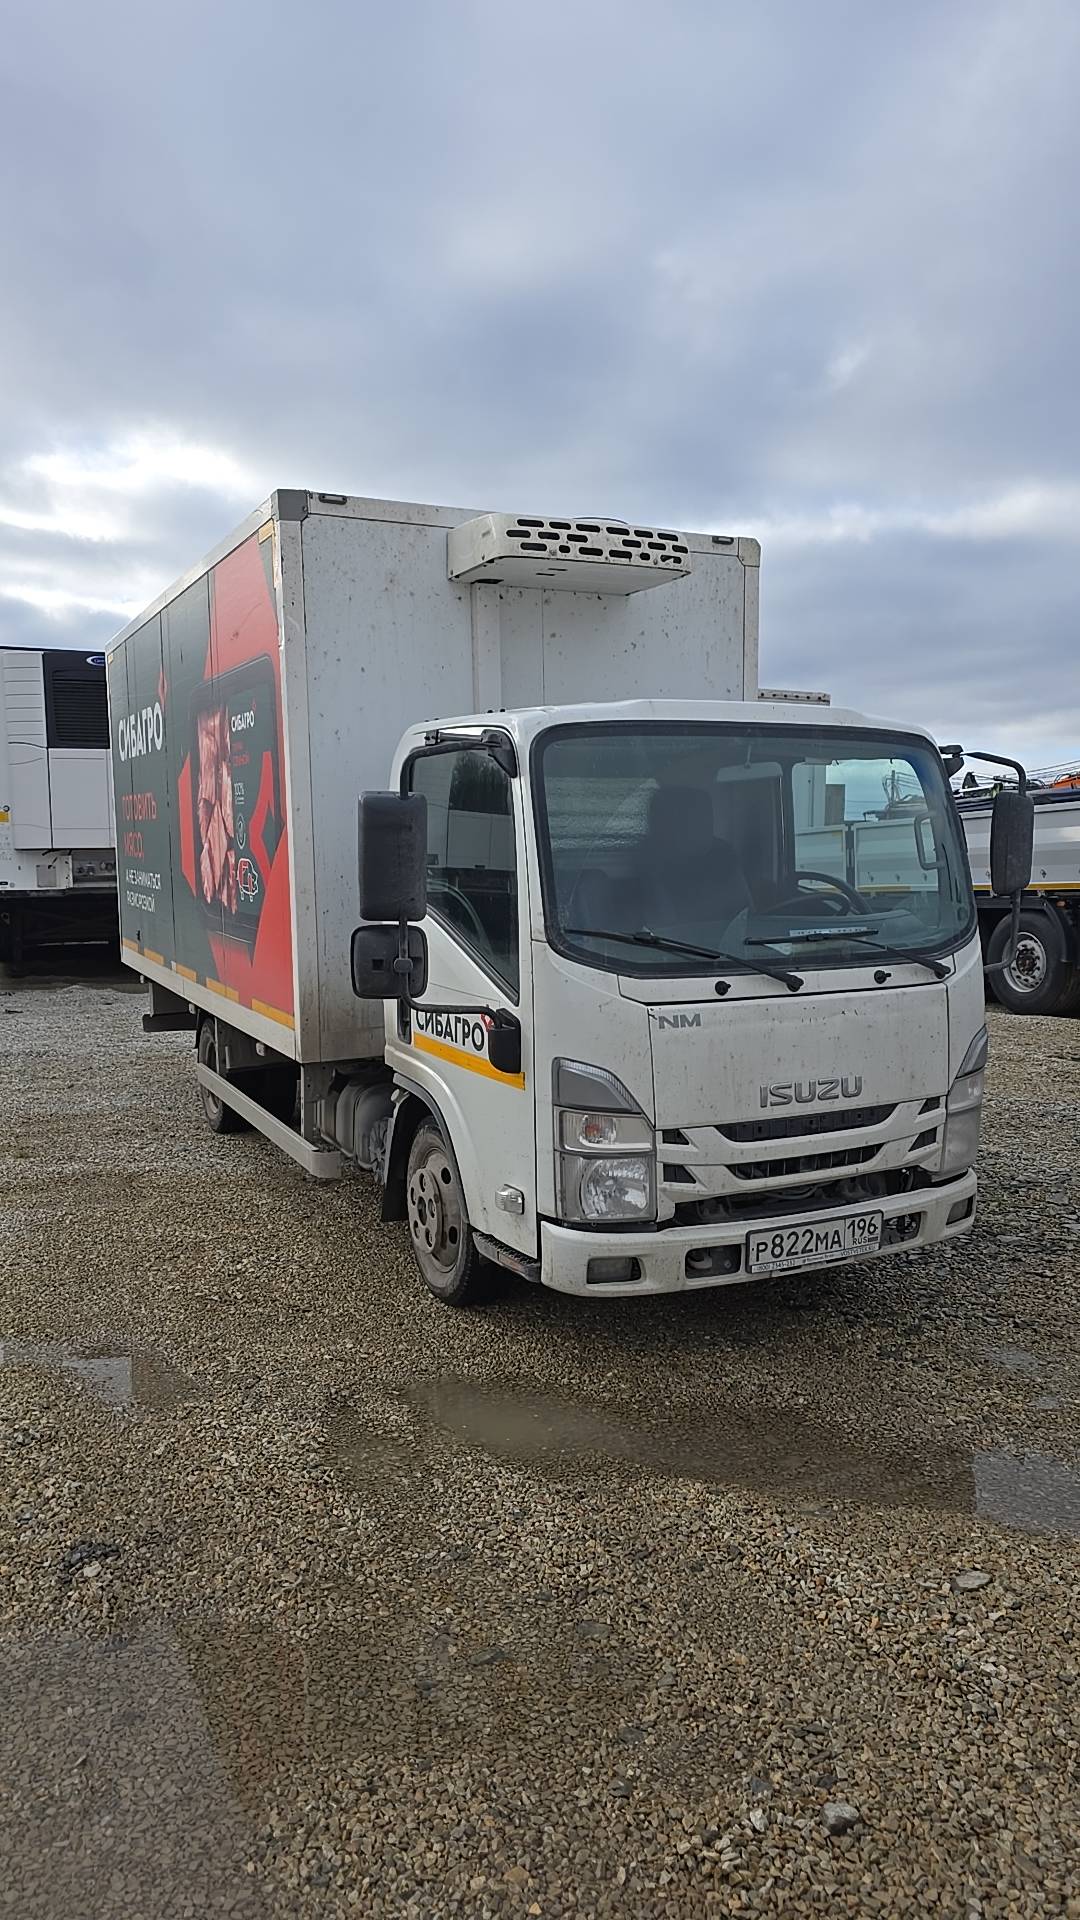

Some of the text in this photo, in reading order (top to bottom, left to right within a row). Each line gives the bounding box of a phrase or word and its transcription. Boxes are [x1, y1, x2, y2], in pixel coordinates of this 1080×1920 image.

[119, 702, 163, 762] СИБАГРО
[231, 710, 255, 733] СИБАГРО
[122, 792, 158, 821] ГОТОВИТЬ
[416, 1011, 485, 1052] СИБАГРО
[658, 1013, 701, 1029] NM
[760, 1075, 863, 1108] ISUZU
[847, 1216, 877, 1238] 196
[852, 1237, 868, 1246] RUS
